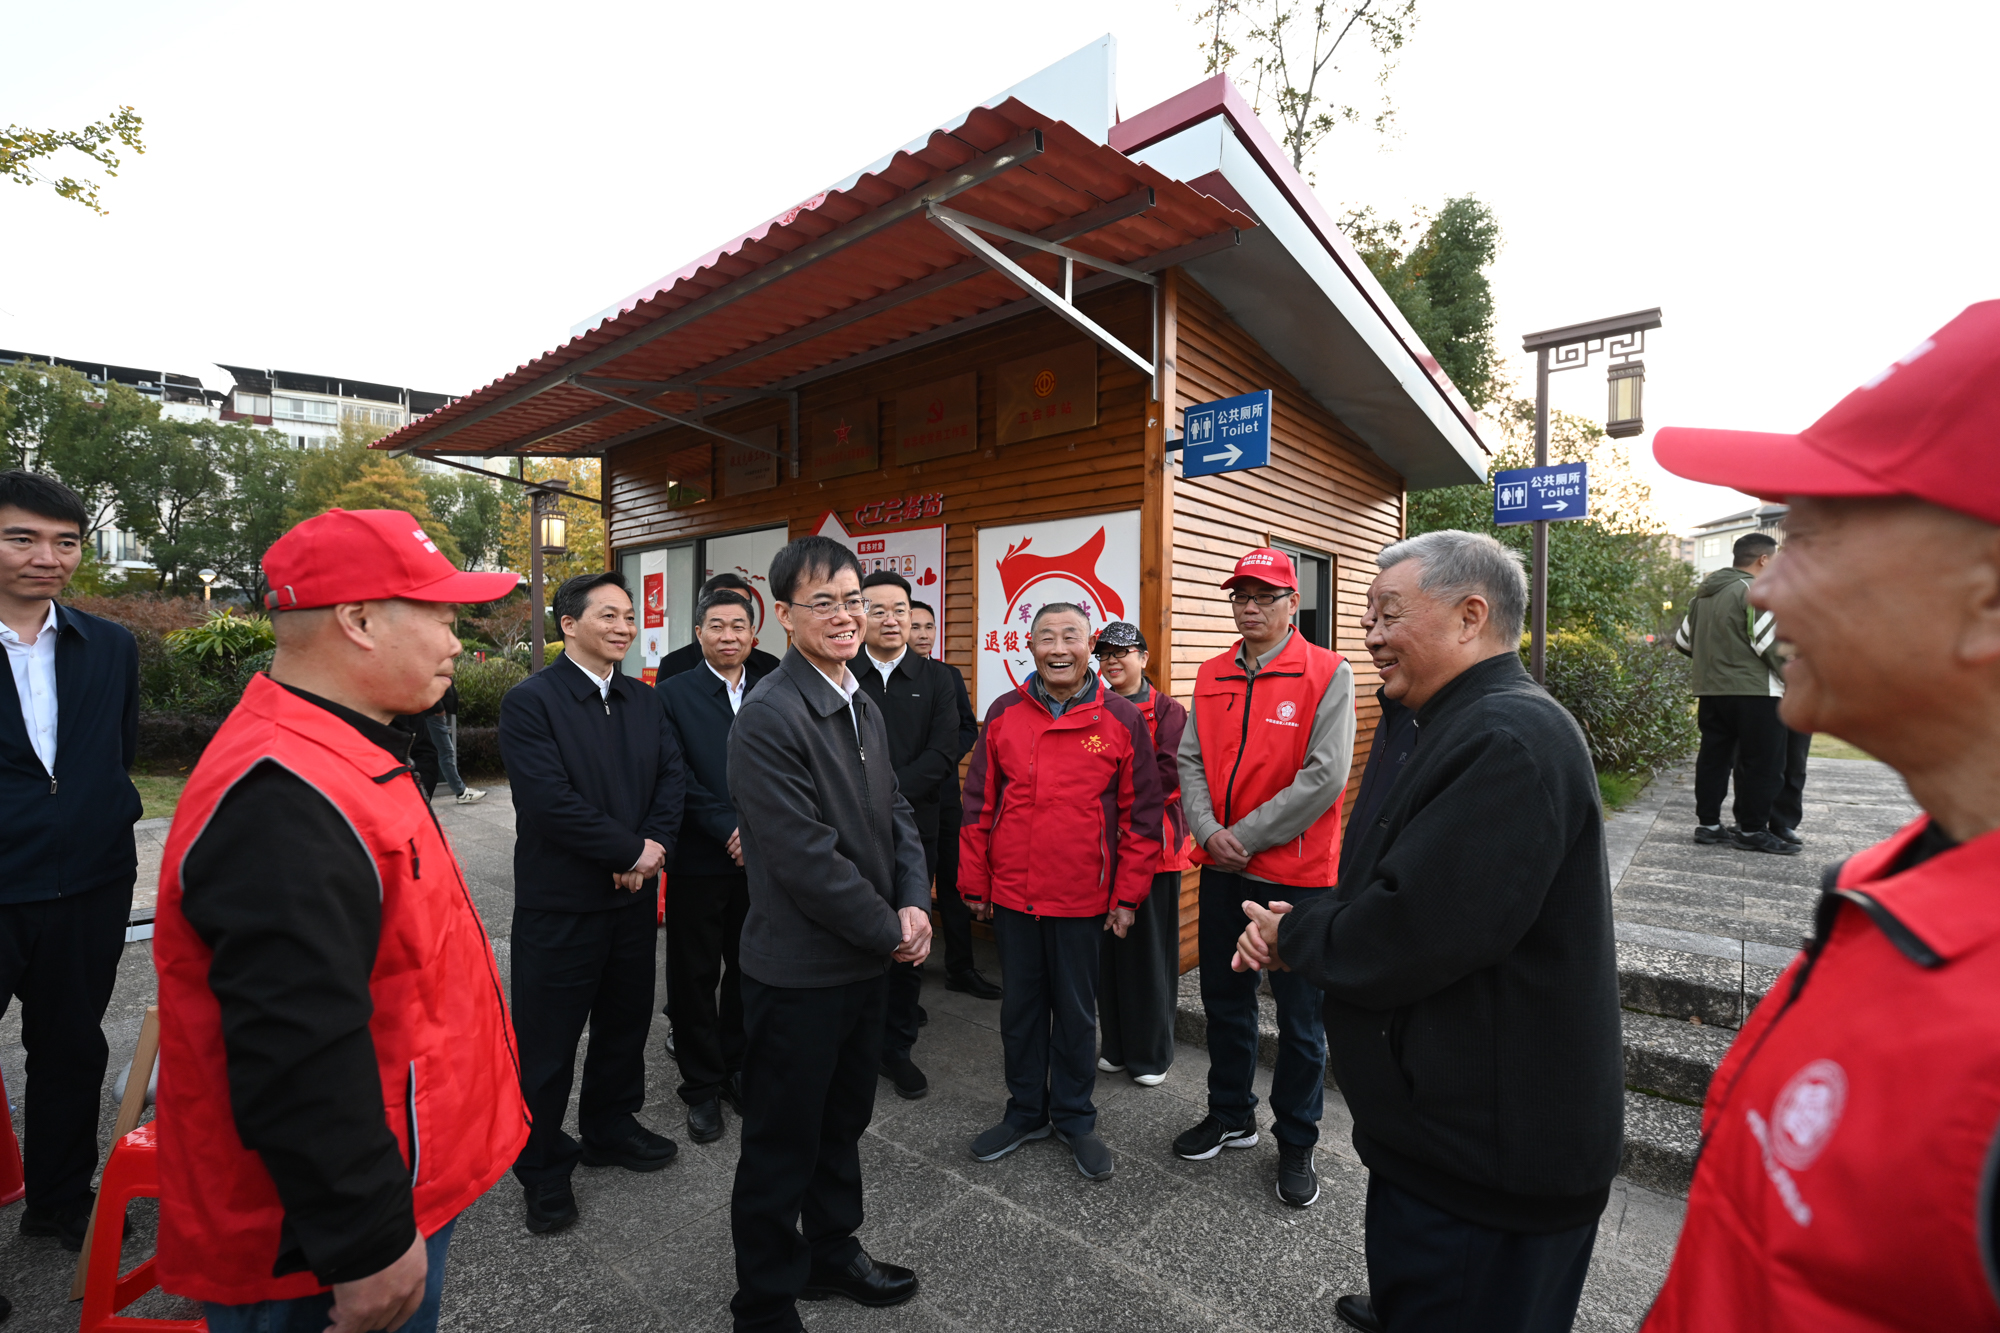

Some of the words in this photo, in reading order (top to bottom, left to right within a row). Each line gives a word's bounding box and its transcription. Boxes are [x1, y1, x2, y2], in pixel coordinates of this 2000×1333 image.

[1018, 401, 1072, 425] 工会驿站
[1217, 403, 1263, 424] 公共厕所
[1221, 420, 1259, 437] Toilet
[1530, 471, 1581, 488] 公共厕所
[1538, 485, 1580, 498] Toilet
[857, 492, 944, 526] 工会驿站
[860, 542, 883, 552] 服务对象
